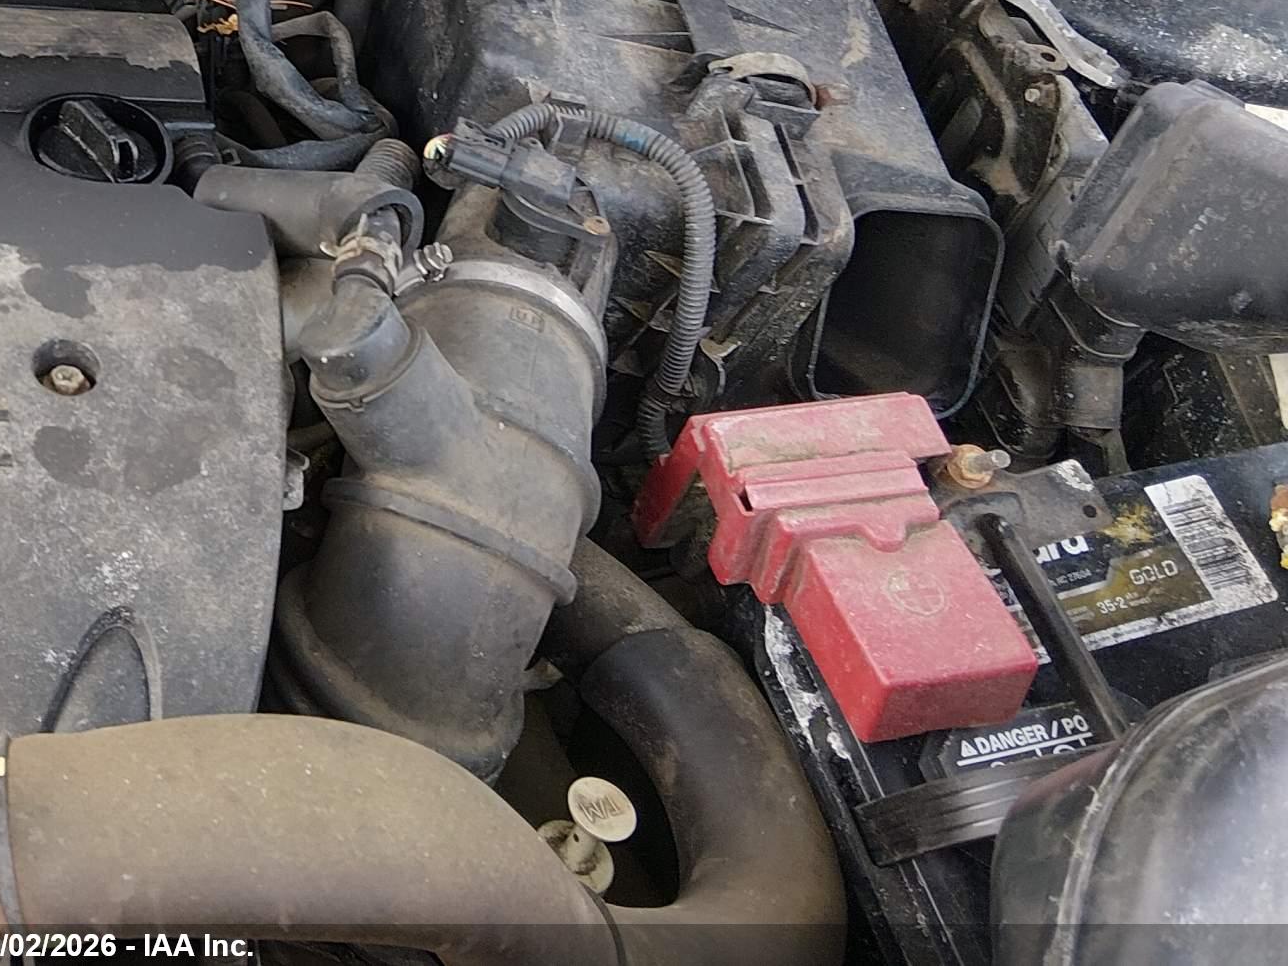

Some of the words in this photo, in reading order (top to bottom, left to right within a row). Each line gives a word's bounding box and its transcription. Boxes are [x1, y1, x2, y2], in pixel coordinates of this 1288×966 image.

[1128, 559, 1179, 585] GOLD
[1096, 596, 1129, 615] 35-2
[973, 723, 1048, 755] DANGER
